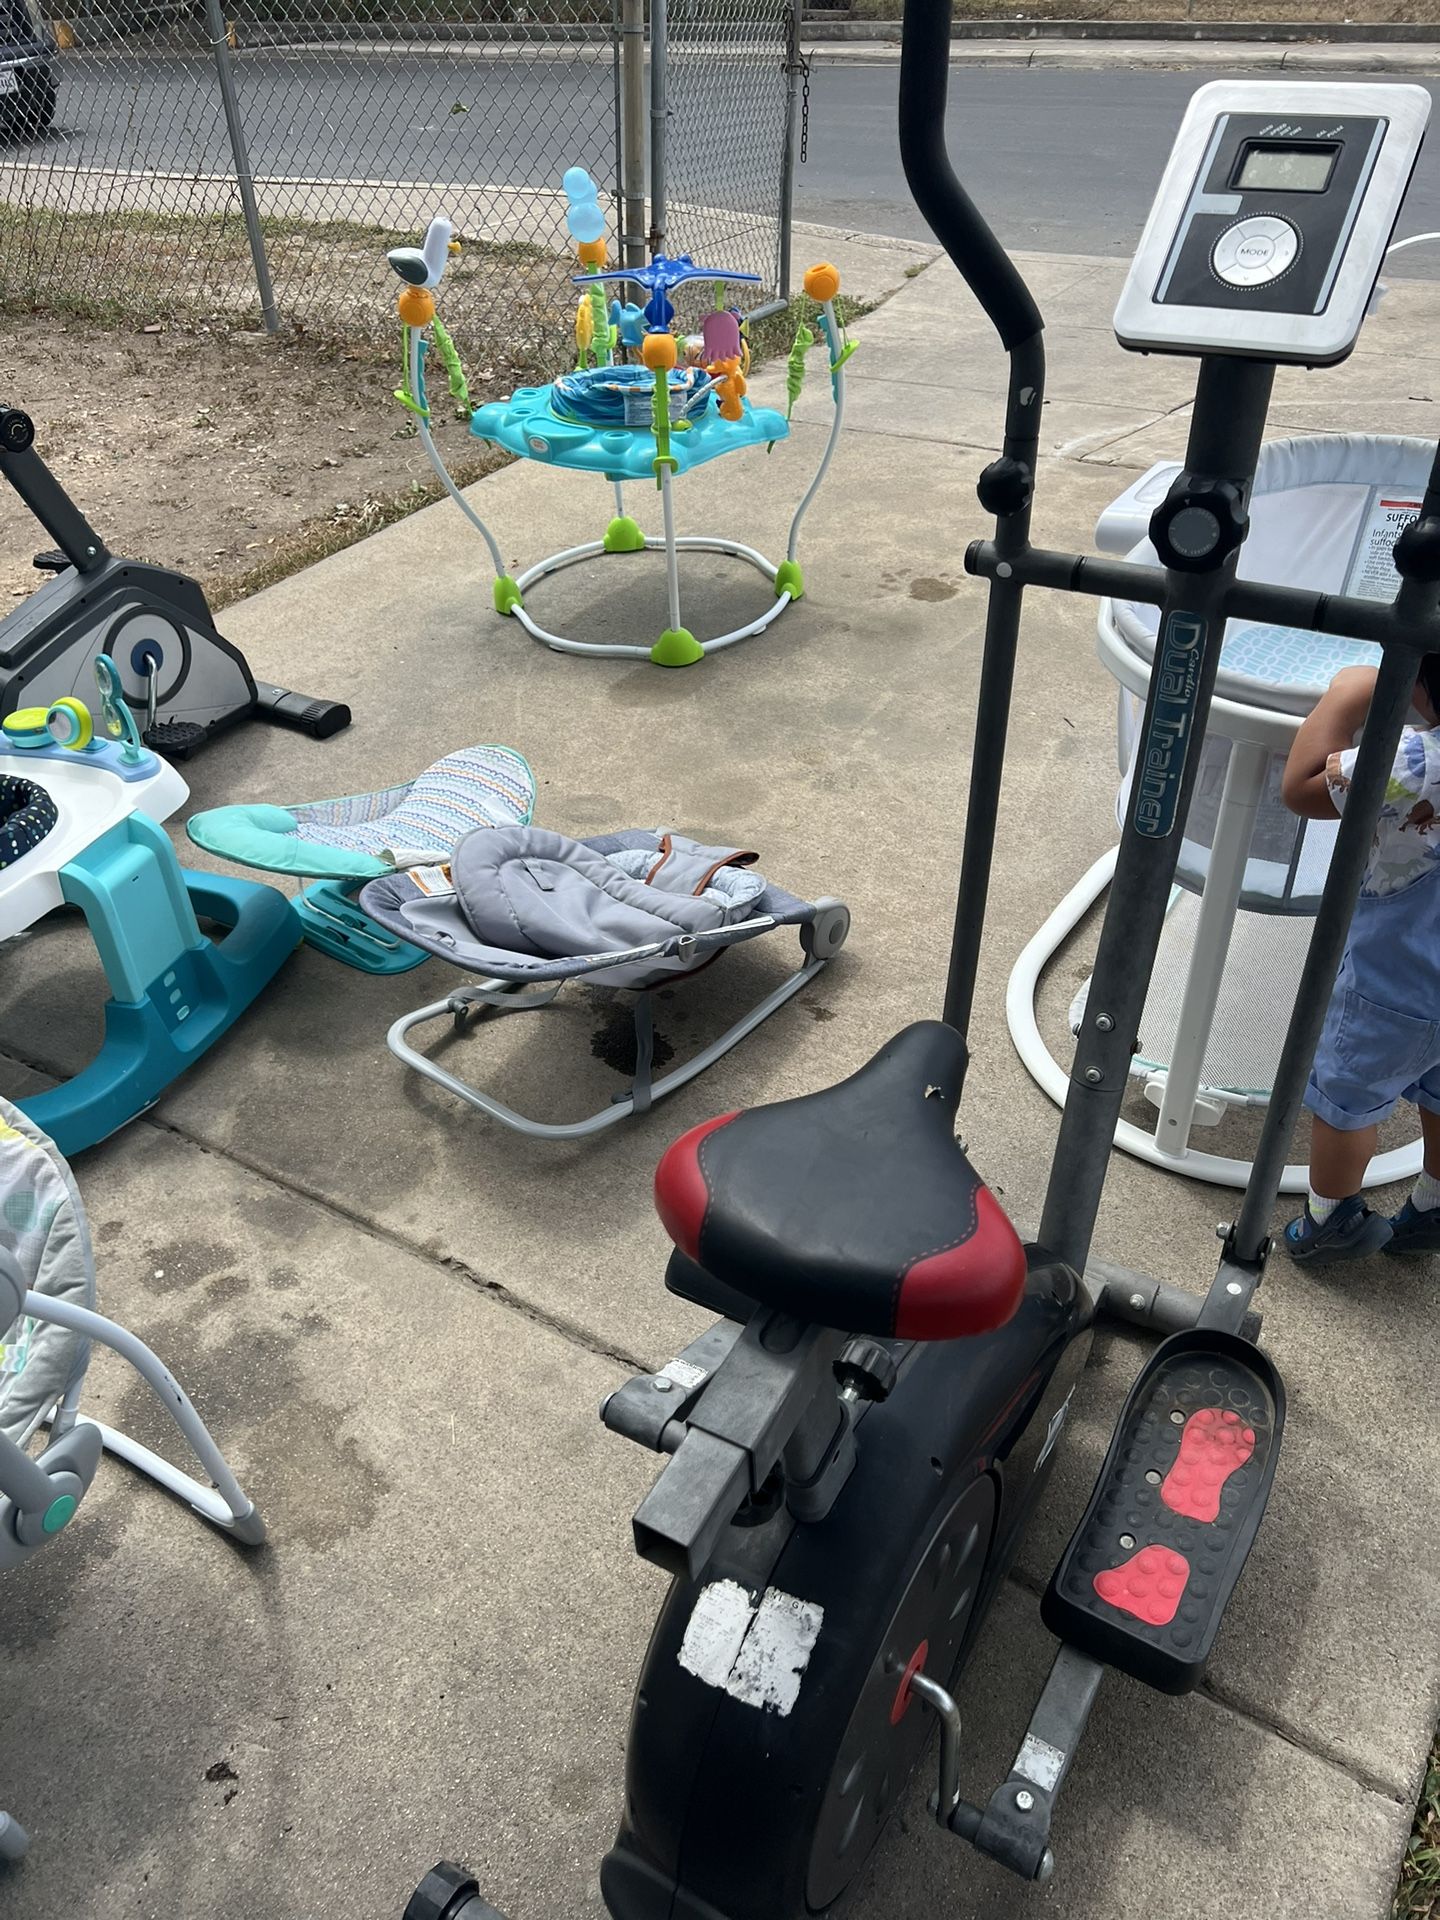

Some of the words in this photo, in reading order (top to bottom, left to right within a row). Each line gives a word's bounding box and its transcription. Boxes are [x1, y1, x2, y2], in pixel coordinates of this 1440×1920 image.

[1240, 248, 1269, 256] MODE
[1159, 619, 1201, 704] Dual
[1183, 649, 1200, 698] Cardio
[1137, 712, 1187, 834] Trainer
